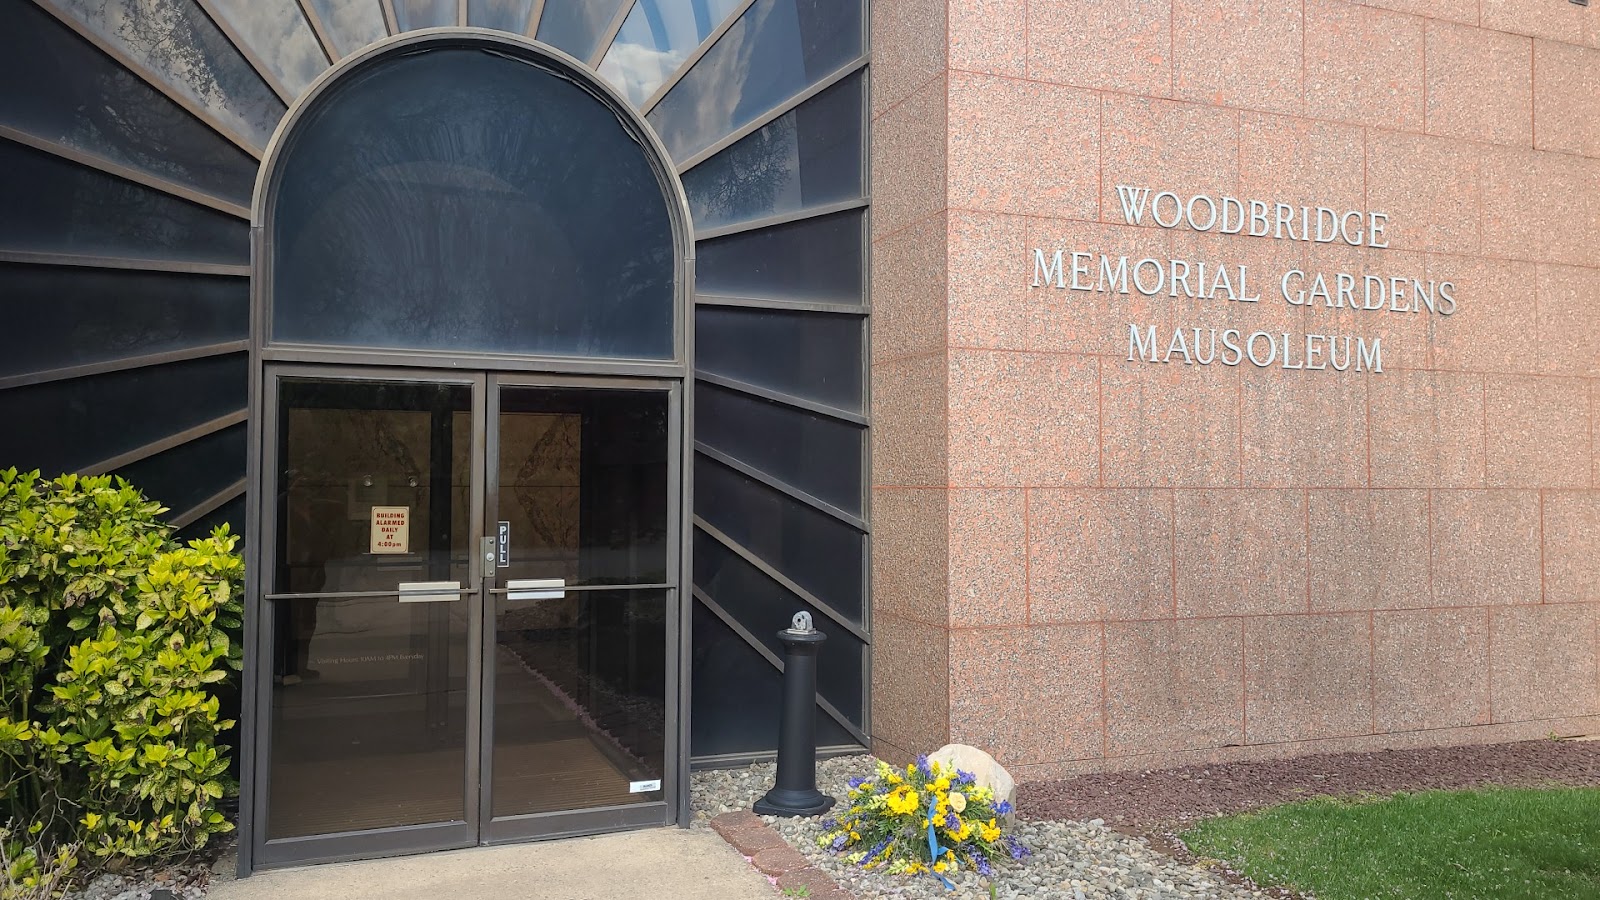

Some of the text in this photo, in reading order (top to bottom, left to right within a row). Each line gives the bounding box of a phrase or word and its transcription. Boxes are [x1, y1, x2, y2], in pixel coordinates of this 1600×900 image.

[1115, 185, 1390, 249] WOODBRIDGE
[1031, 248, 1457, 315] MEMORIAL GARDENS
[1127, 323, 1383, 374] MAUSOLEUM
